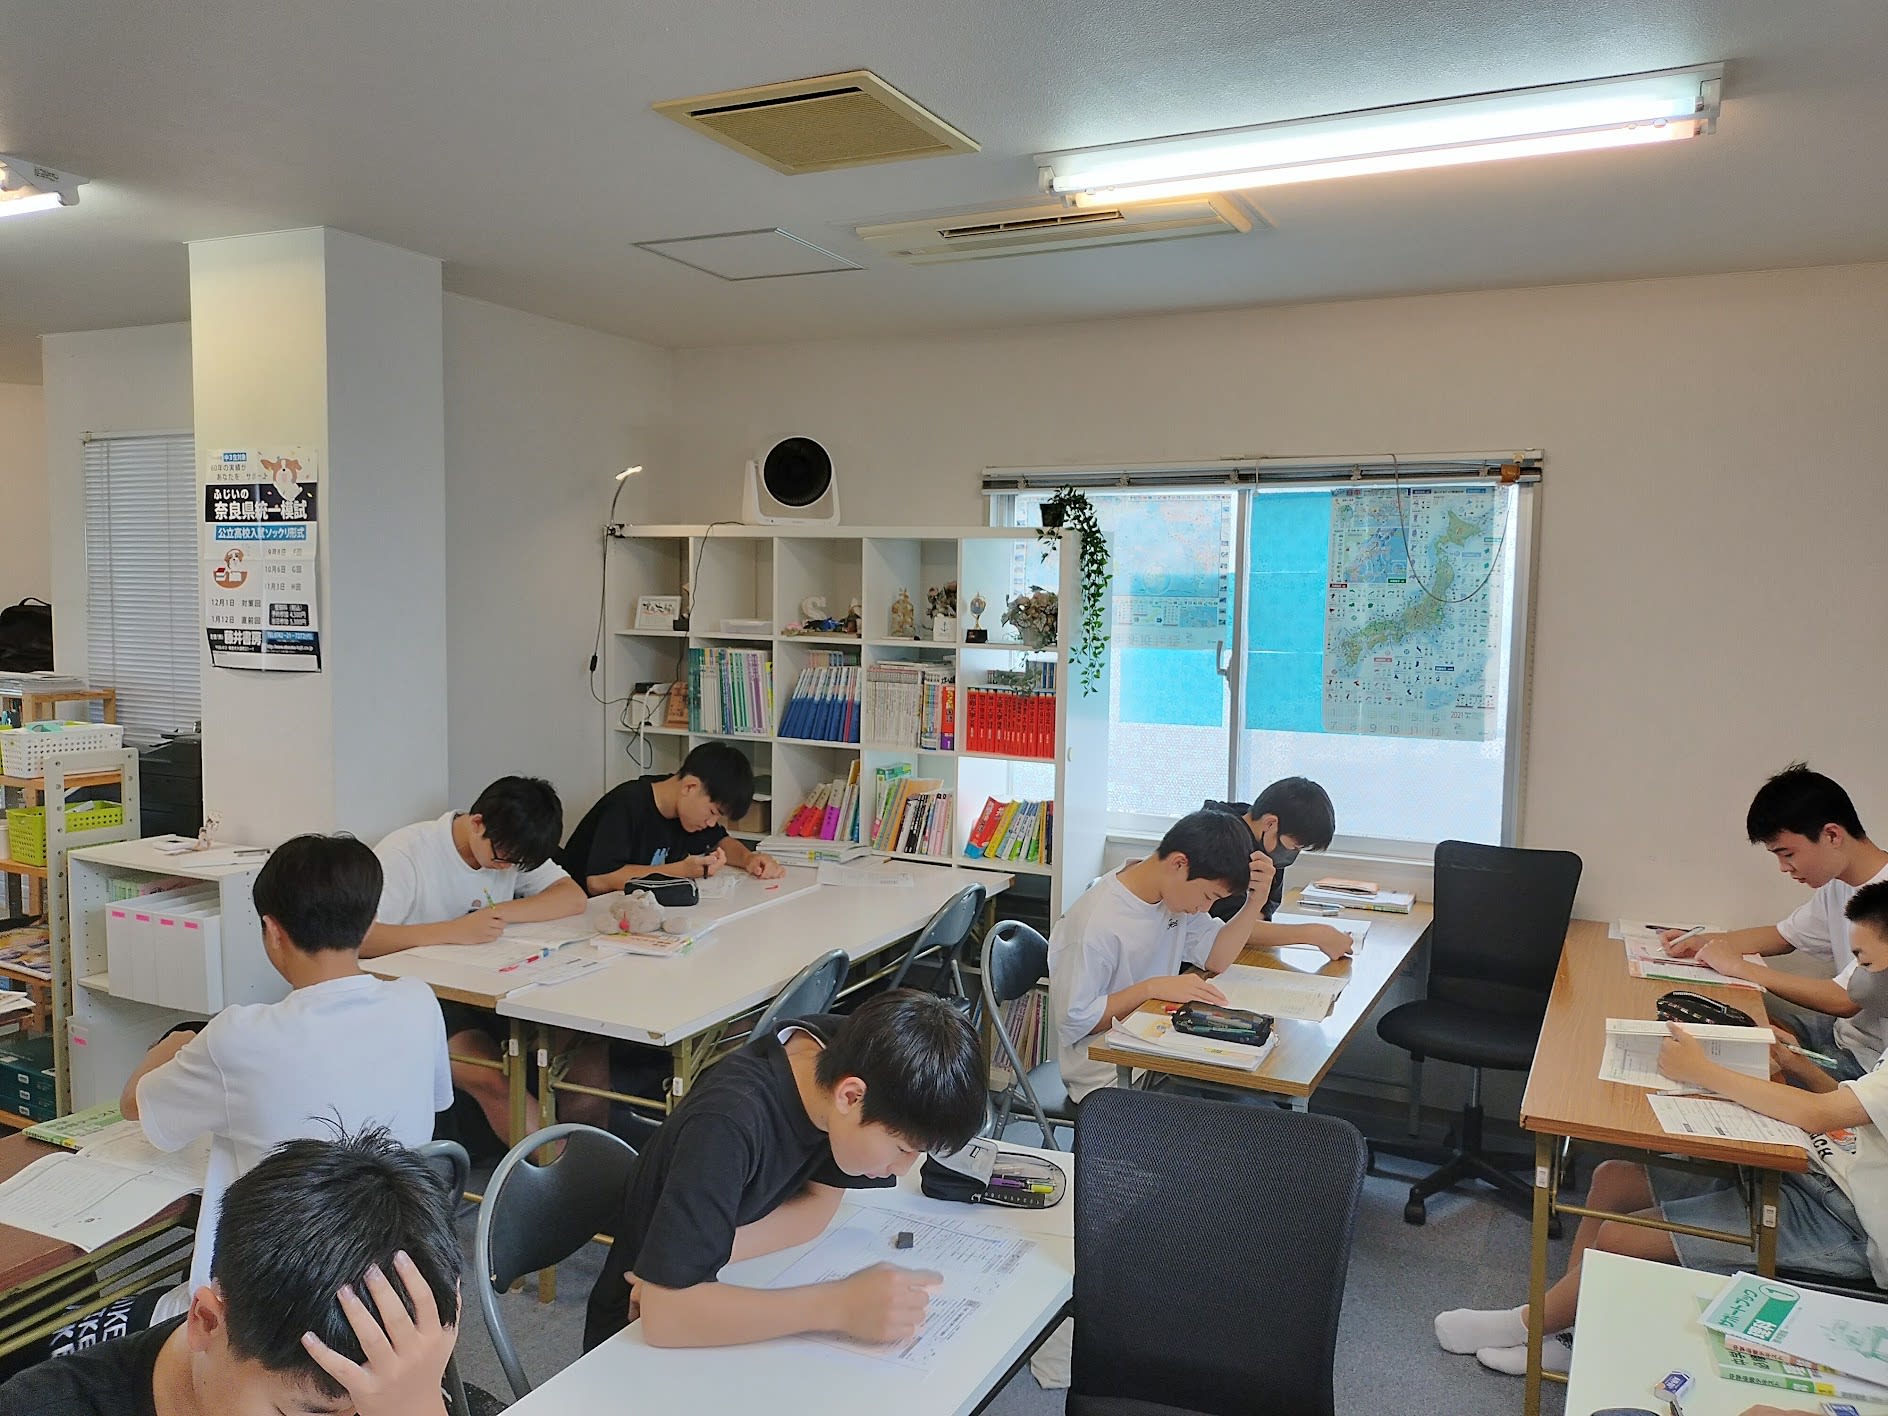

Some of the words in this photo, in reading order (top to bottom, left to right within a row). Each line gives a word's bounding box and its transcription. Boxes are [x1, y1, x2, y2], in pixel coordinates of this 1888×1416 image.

[214, 489, 249, 500] ふじいの
[214, 500, 307, 520] 奈良県統一模試
[212, 616, 234, 624] 1月12日
[224, 630, 262, 646] 藤井書房
[1718, 1288, 1758, 1328] サポートブック
